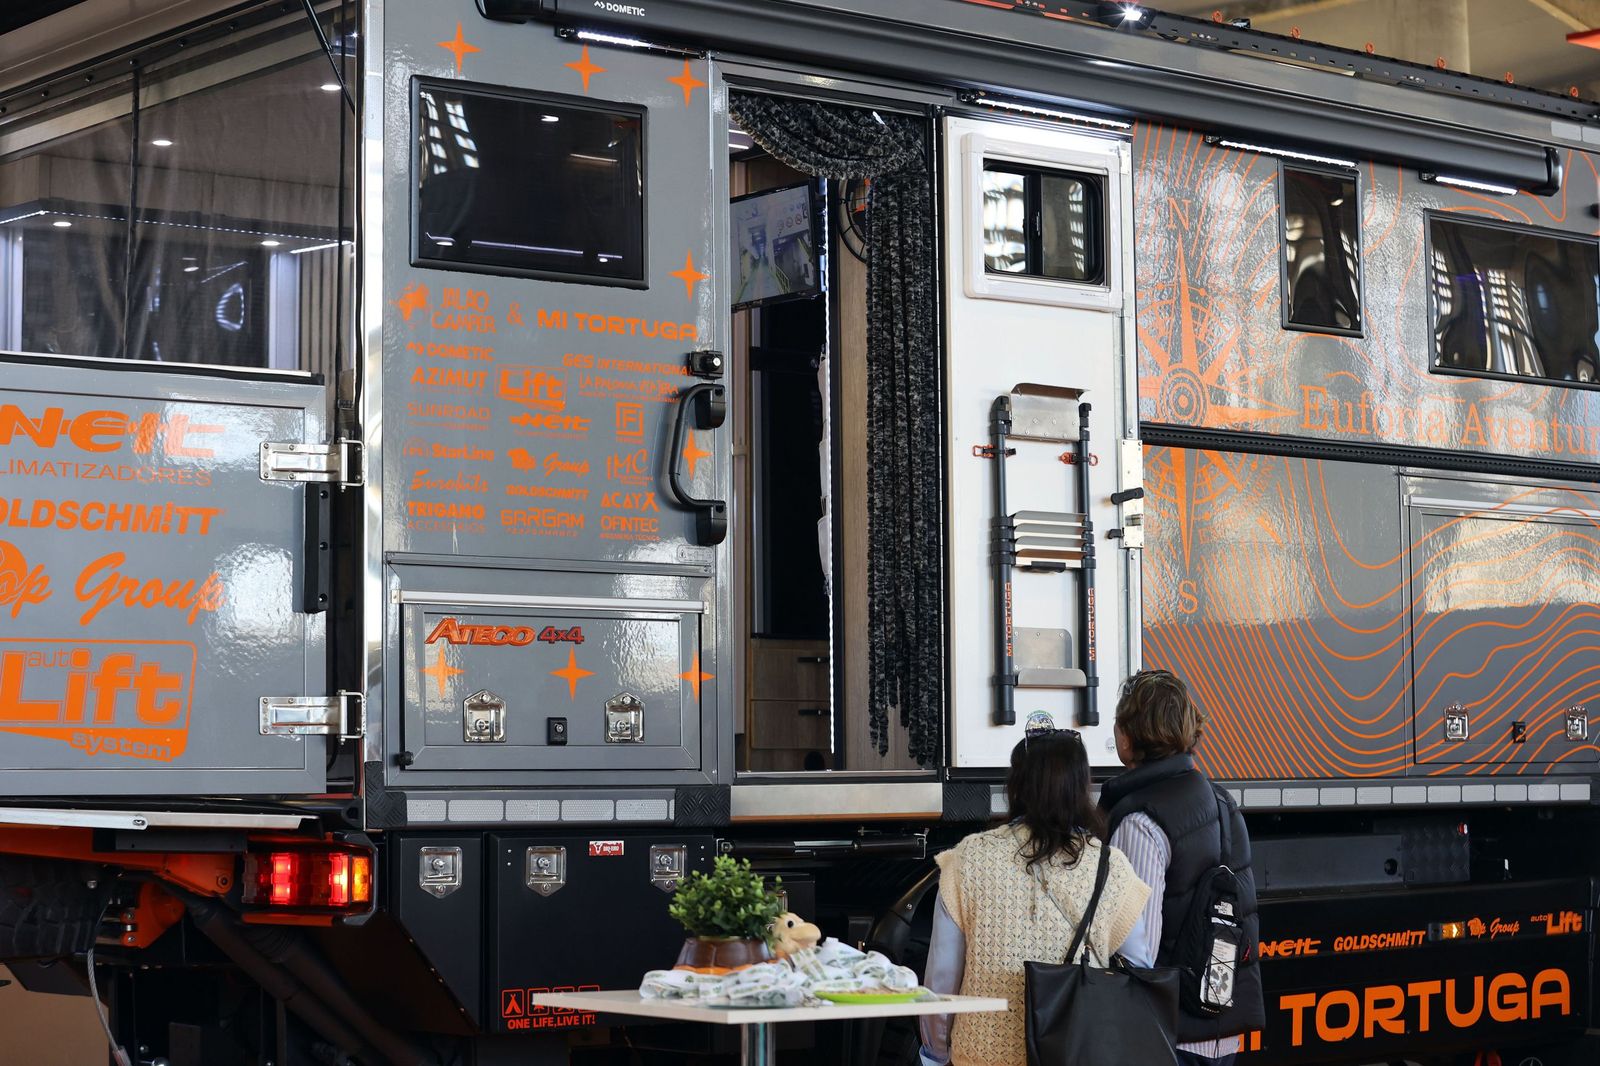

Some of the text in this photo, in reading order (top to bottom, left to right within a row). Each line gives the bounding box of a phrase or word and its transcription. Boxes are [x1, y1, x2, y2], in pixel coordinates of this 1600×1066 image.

[606, 2, 646, 17] DOMETIC
[537, 309, 568, 330] MI
[574, 312, 698, 342] TORTUGA
[410, 366, 489, 388] AZIMUT
[0, 458, 212, 487] IMATIZADORES
[407, 501, 486, 520] TRIGANO
[74, 552, 228, 626] Group
[538, 626, 585, 644] 4x4
[0, 649, 184, 726] Lift
[70, 729, 172, 760] system
[1490, 917, 1520, 942] Group
[1279, 968, 1571, 1047] TORTUGA
[507, 1018, 530, 1030] ONE
[582, 1013, 596, 1025] IT!
